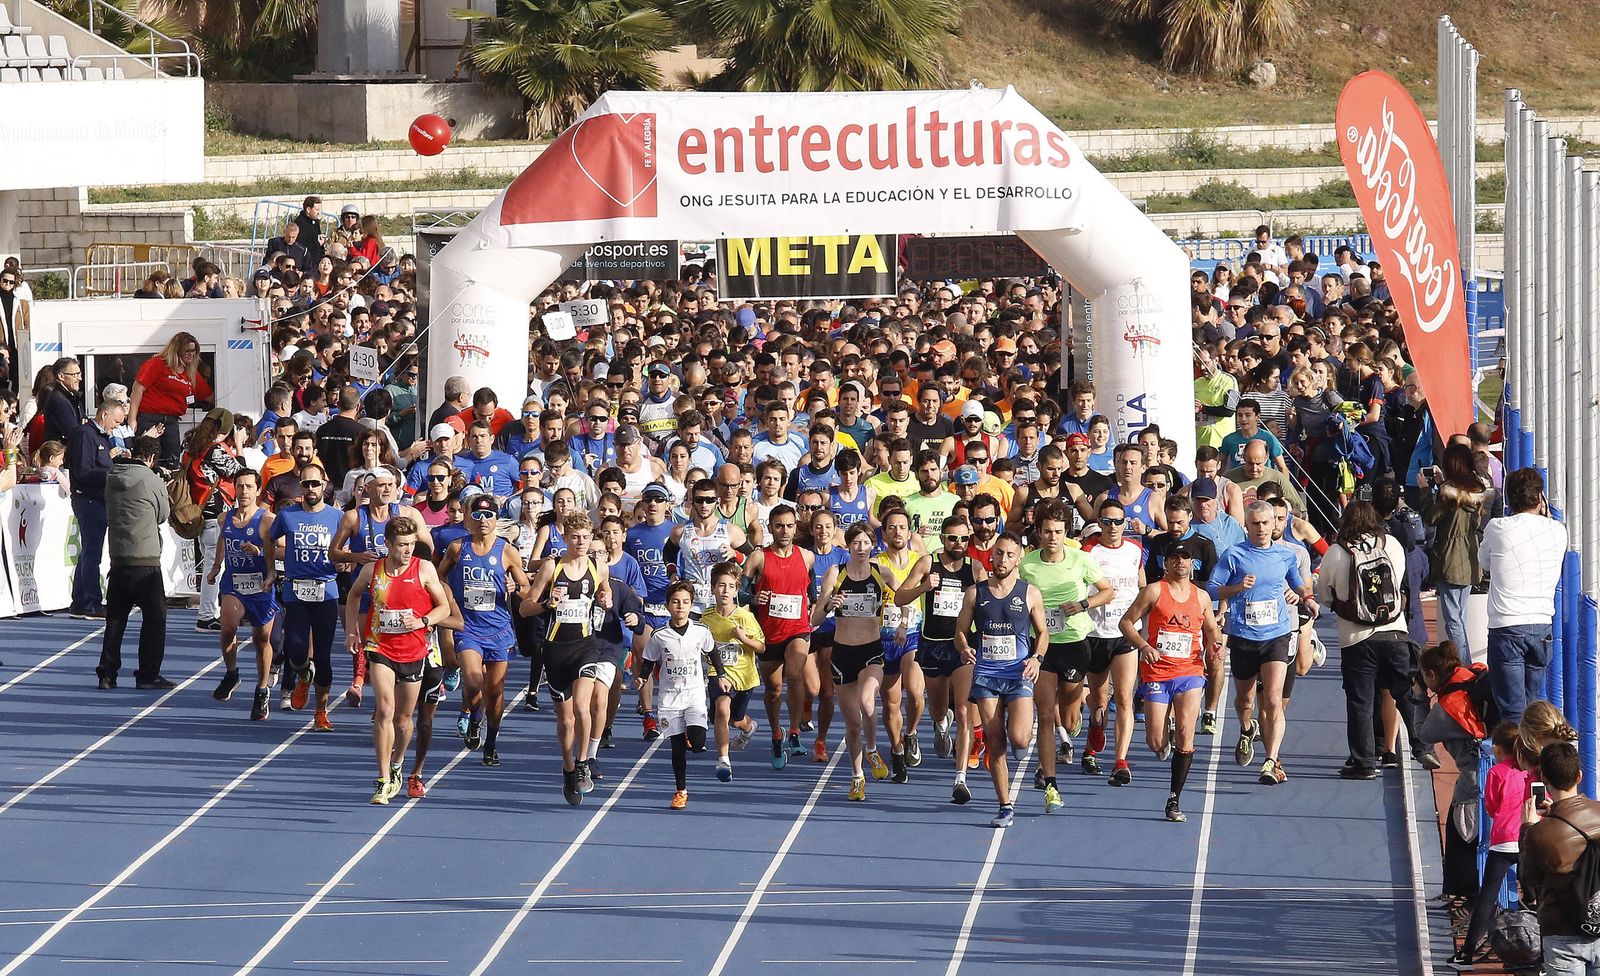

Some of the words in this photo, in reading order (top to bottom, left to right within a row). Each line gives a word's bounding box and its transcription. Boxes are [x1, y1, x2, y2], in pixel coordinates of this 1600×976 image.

[643, 117, 652, 150] ALEGRÍA
[677, 105, 1071, 175] entreculturas
[644, 159, 652, 168] FE
[680, 195, 713, 208] ONG
[718, 194, 776, 207] JESUITA
[782, 192, 818, 206] PARA
[824, 192, 840, 204] LA
[846, 186, 934, 203] EDUCACIÓN
[940, 188, 948, 200] Y
[954, 188, 971, 200] EL
[976, 186, 1072, 200] DESARROLLO
[727, 234, 889, 277] META
[585, 260, 618, 268] eventos
[620, 259, 666, 269] deportivos
[451, 303, 497, 319] corre
[570, 303, 599, 317] 5:30
[353, 351, 375, 369] 4:30
[298, 522, 328, 534] Triatlón
[294, 532, 332, 550] RCM
[227, 555, 255, 568] 1873
[295, 549, 329, 563] 1873
[463, 565, 495, 582] RCM
[241, 582, 255, 590] 120
[301, 587, 317, 596] 292
[473, 596, 484, 605] 52
[942, 601, 959, 610] 345
[778, 603, 793, 613] 261
[854, 602, 865, 611] 36
[562, 608, 584, 617] 4016
[1251, 611, 1272, 620] 4594
[988, 646, 1010, 655] 4230
[1165, 641, 1182, 652] 282
[672, 666, 693, 675] 4282
